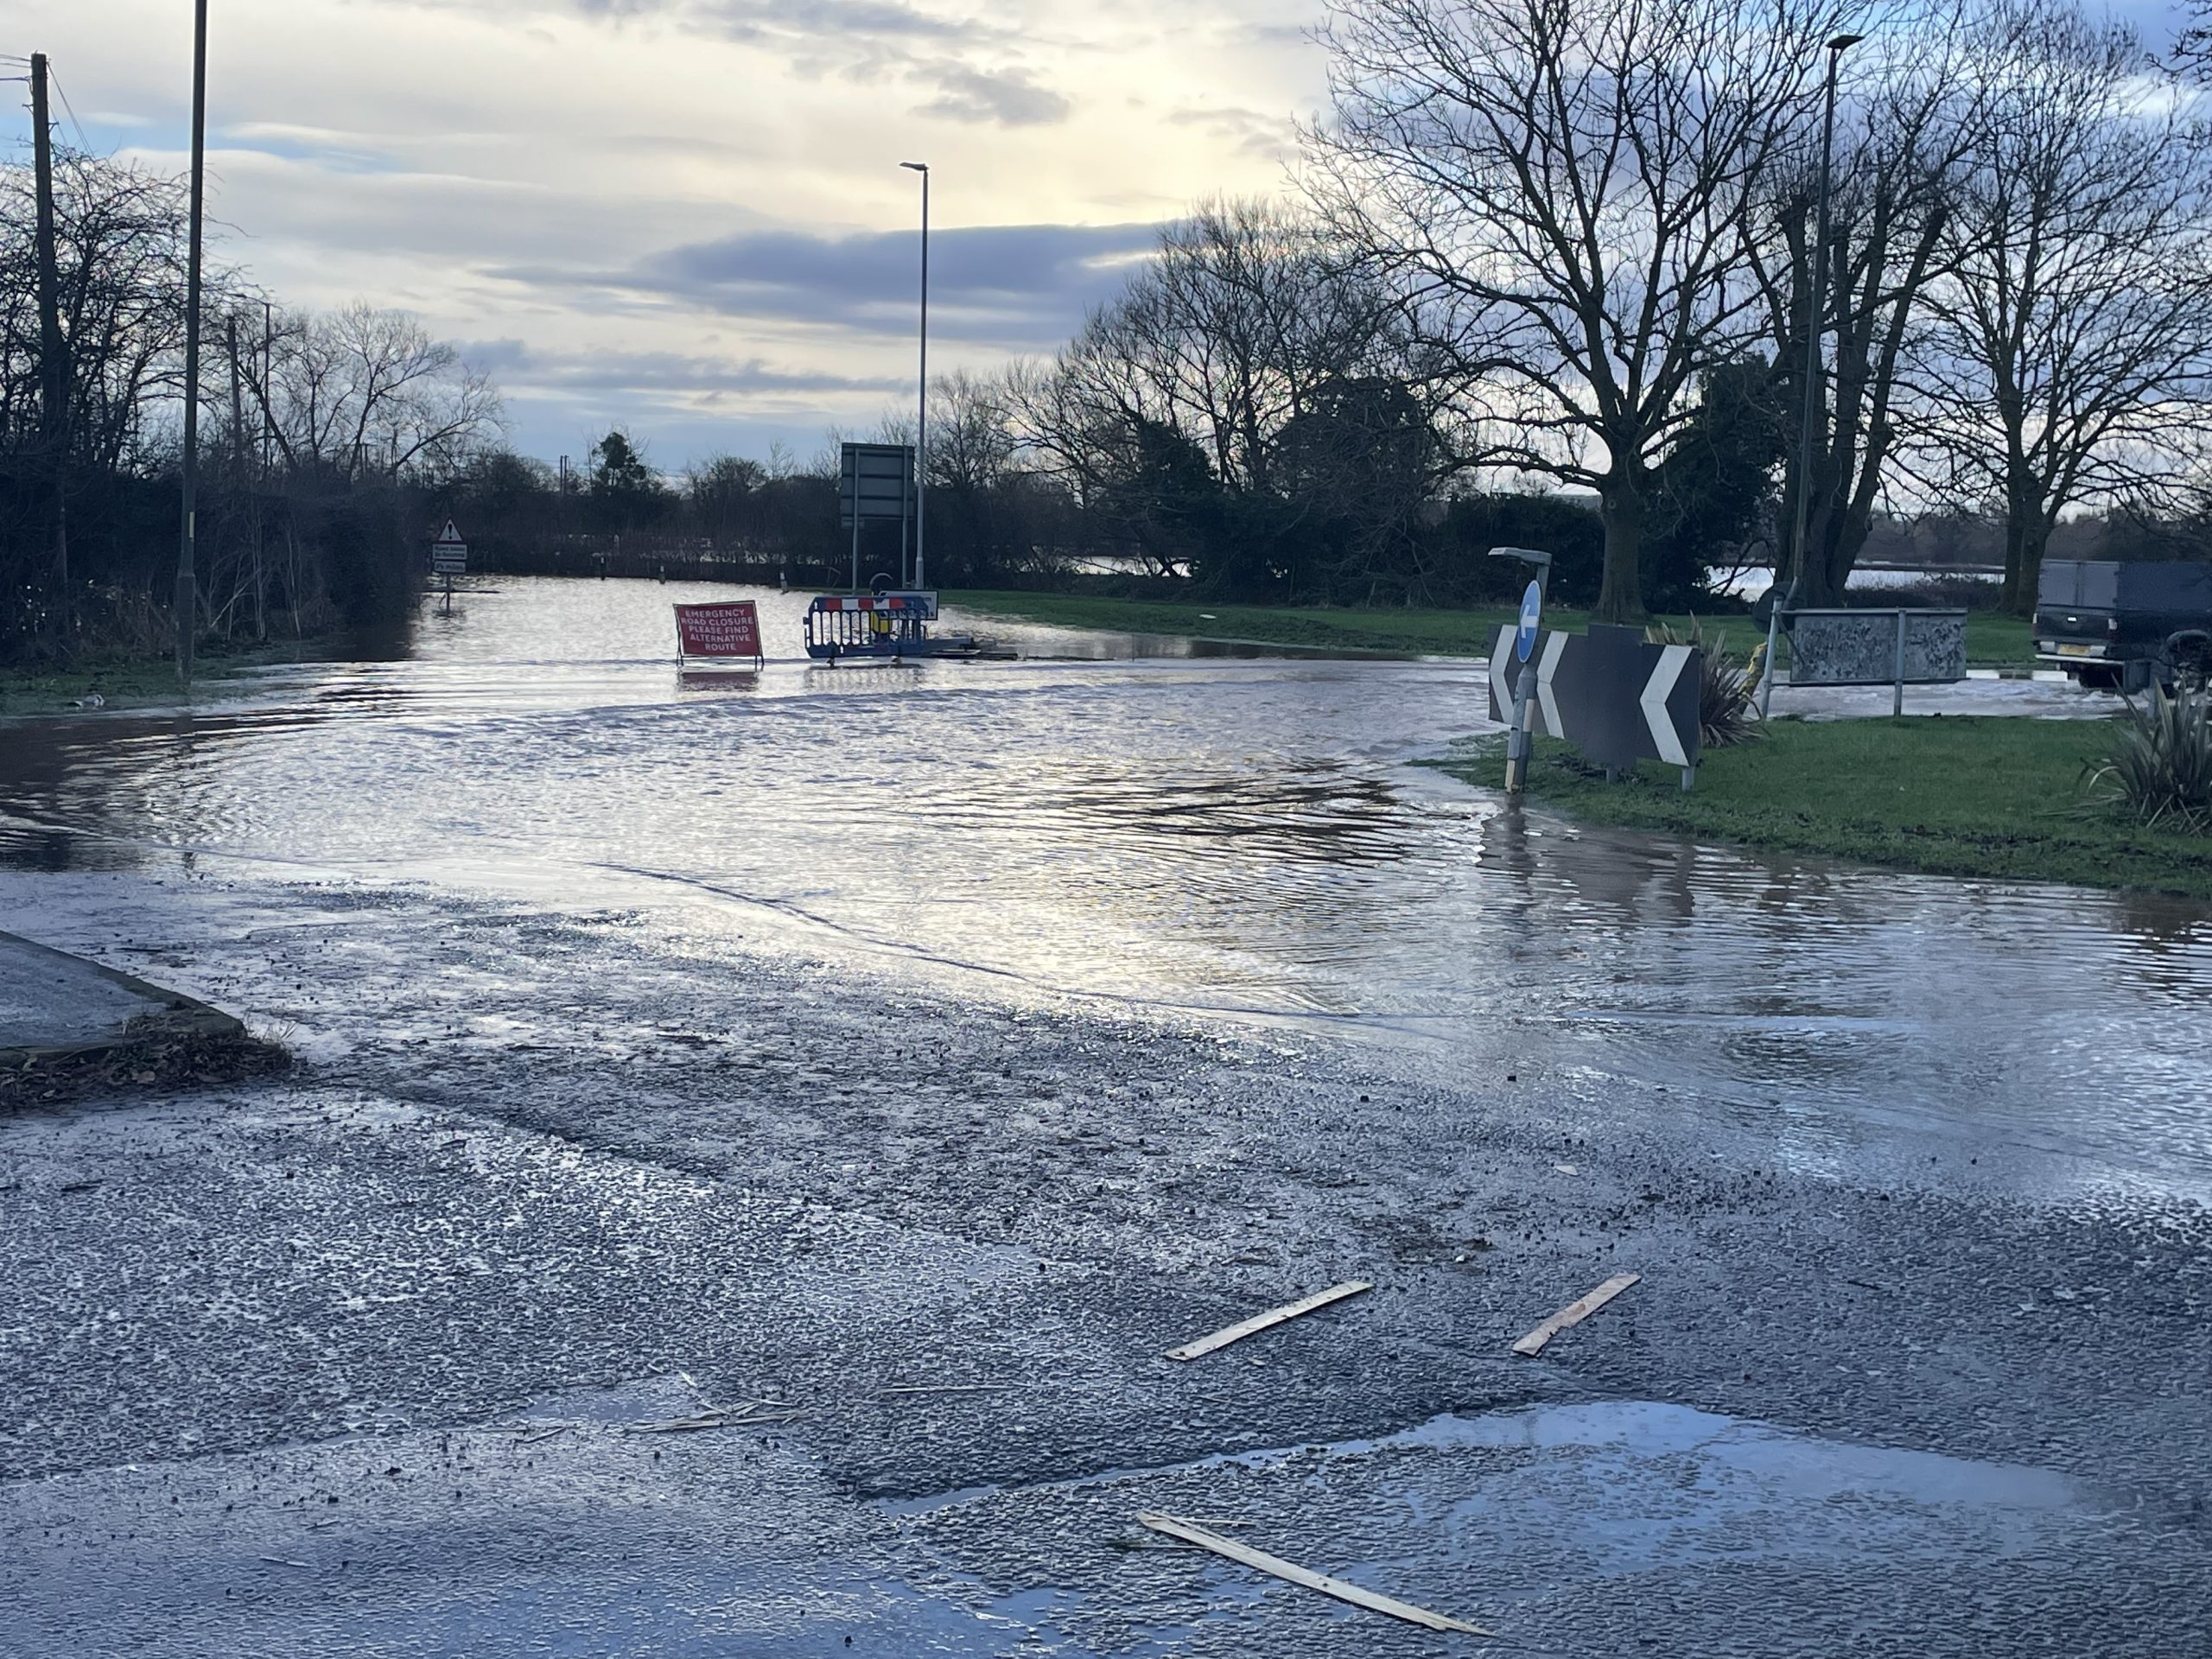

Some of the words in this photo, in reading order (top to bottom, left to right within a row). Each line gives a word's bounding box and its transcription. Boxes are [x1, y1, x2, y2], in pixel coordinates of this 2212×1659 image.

[685, 608, 745, 618] EMERGENCY
[681, 617, 707, 626] ROAD
[709, 616, 754, 626] CLOSURE
[689, 626, 721, 634] PLEASE
[690, 633, 751, 643] ALTERNATIVE
